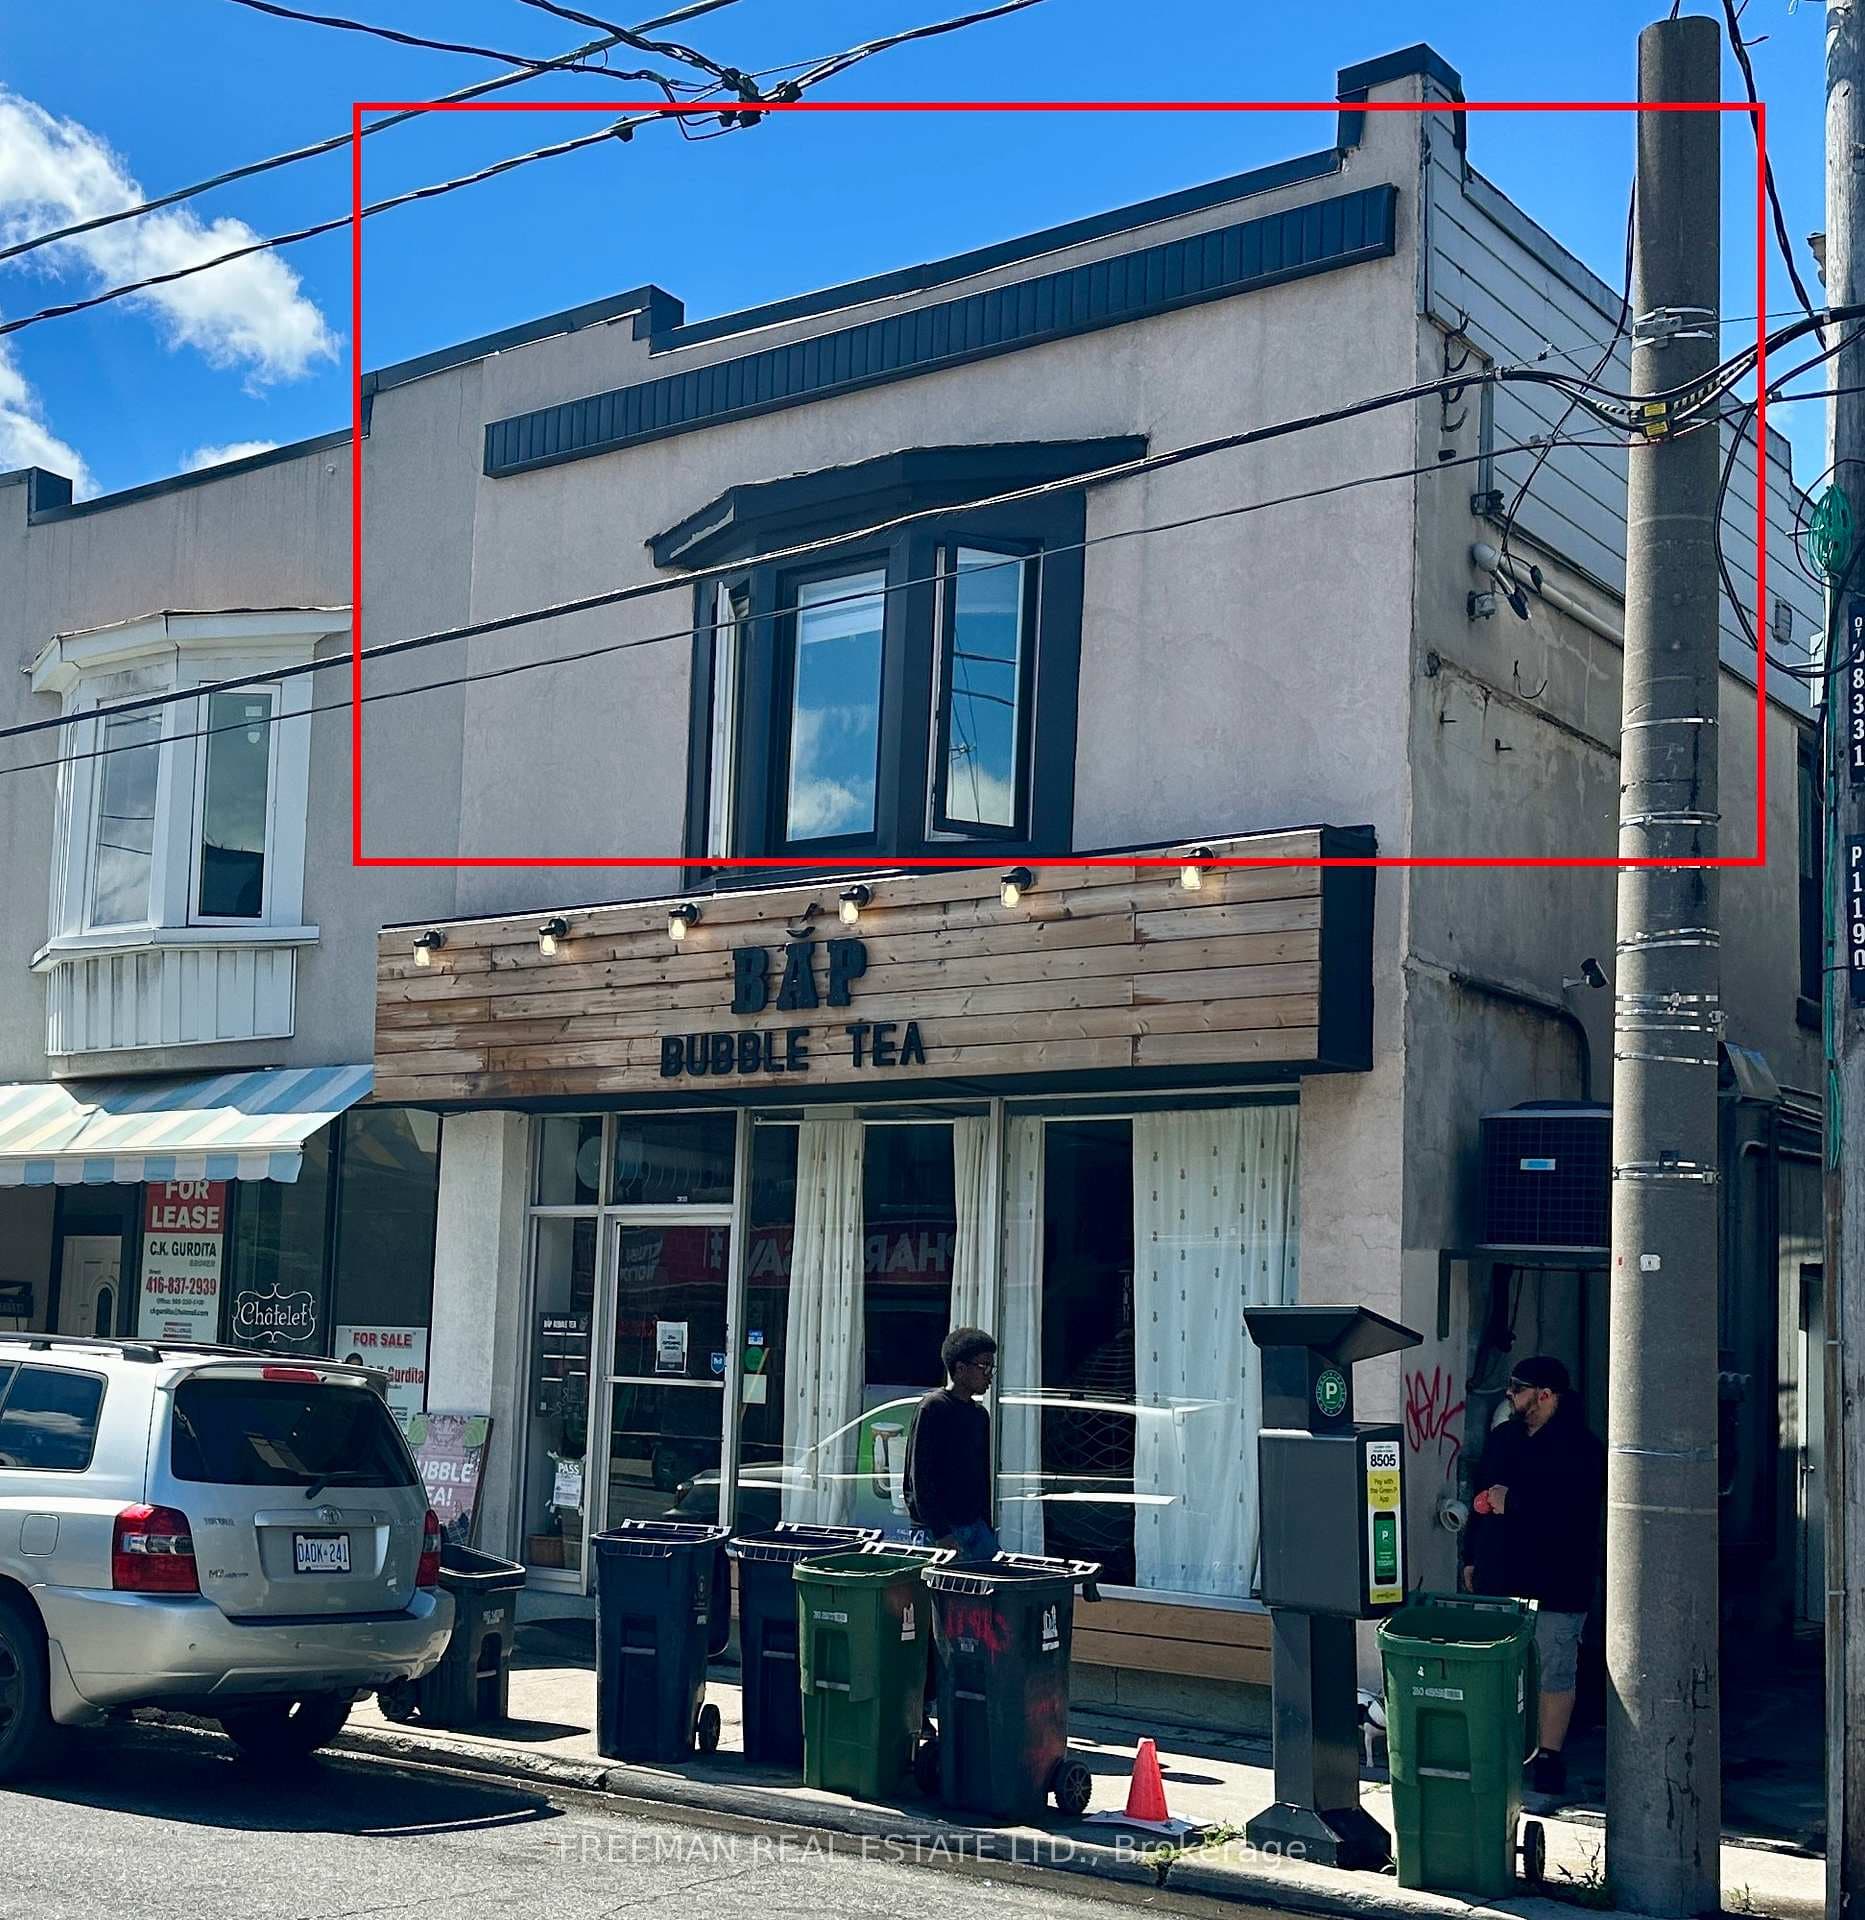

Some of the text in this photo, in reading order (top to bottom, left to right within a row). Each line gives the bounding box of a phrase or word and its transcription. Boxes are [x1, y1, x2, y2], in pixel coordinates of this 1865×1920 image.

[660, 1022, 926, 1077] BUBBLE TEA
[165, 1181, 209, 1200] FOR
[151, 1205, 220, 1229] LEASE
[171, 1241, 216, 1257] GURDITA
[145, 1276, 217, 1296] 416-837-2939
[240, 1301, 308, 1326] Châtelet
[353, 1332, 412, 1348] FOR SALE
[1326, 1382, 1337, 1400] P
[558, 1462, 580, 1475] PASS
[1370, 1453, 1396, 1467] 8505
[418, 1460, 474, 1483] UBBLE
[425, 1486, 453, 1506] EA!
[329, 1543, 348, 1563] 241
